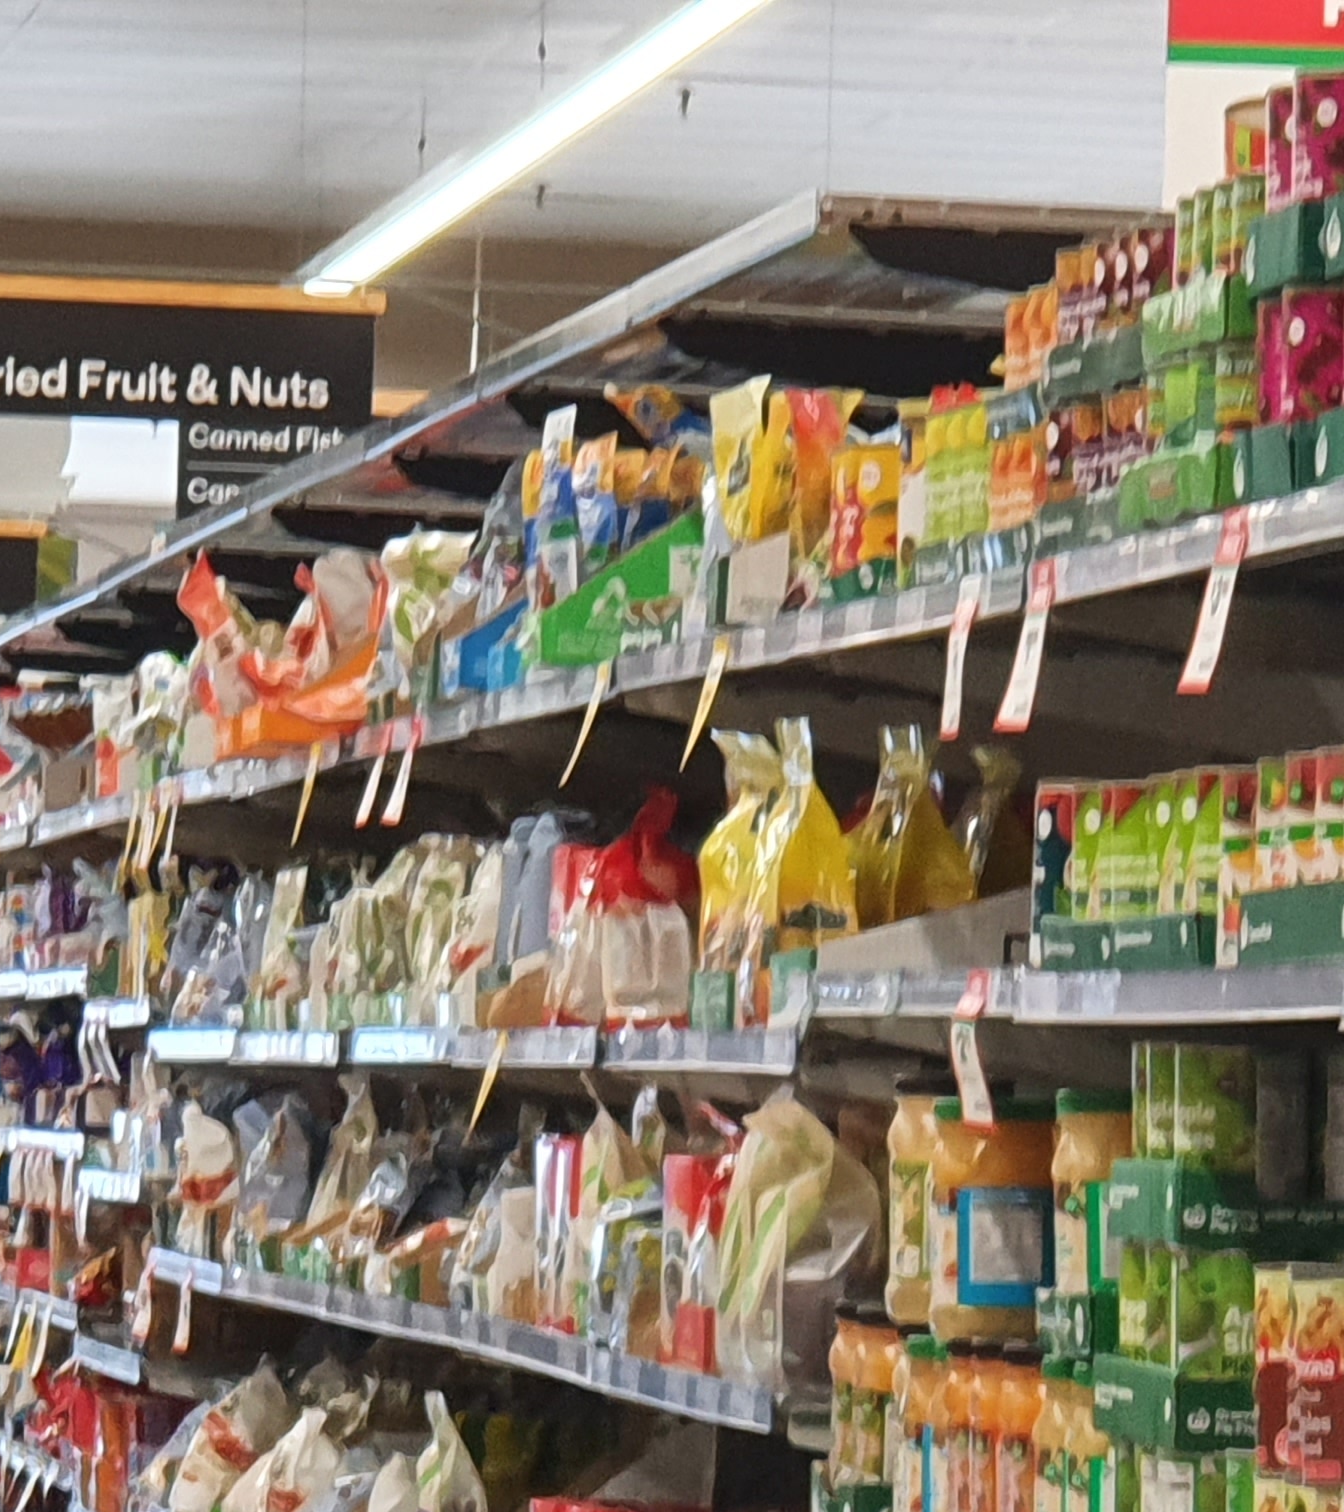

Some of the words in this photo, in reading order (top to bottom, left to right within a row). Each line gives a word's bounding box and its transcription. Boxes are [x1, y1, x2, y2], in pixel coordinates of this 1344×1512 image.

[77, 357, 177, 404] Fruit
[184, 365, 220, 406] &
[229, 370, 331, 411] Nuts
[189, 422, 291, 453] Canned
